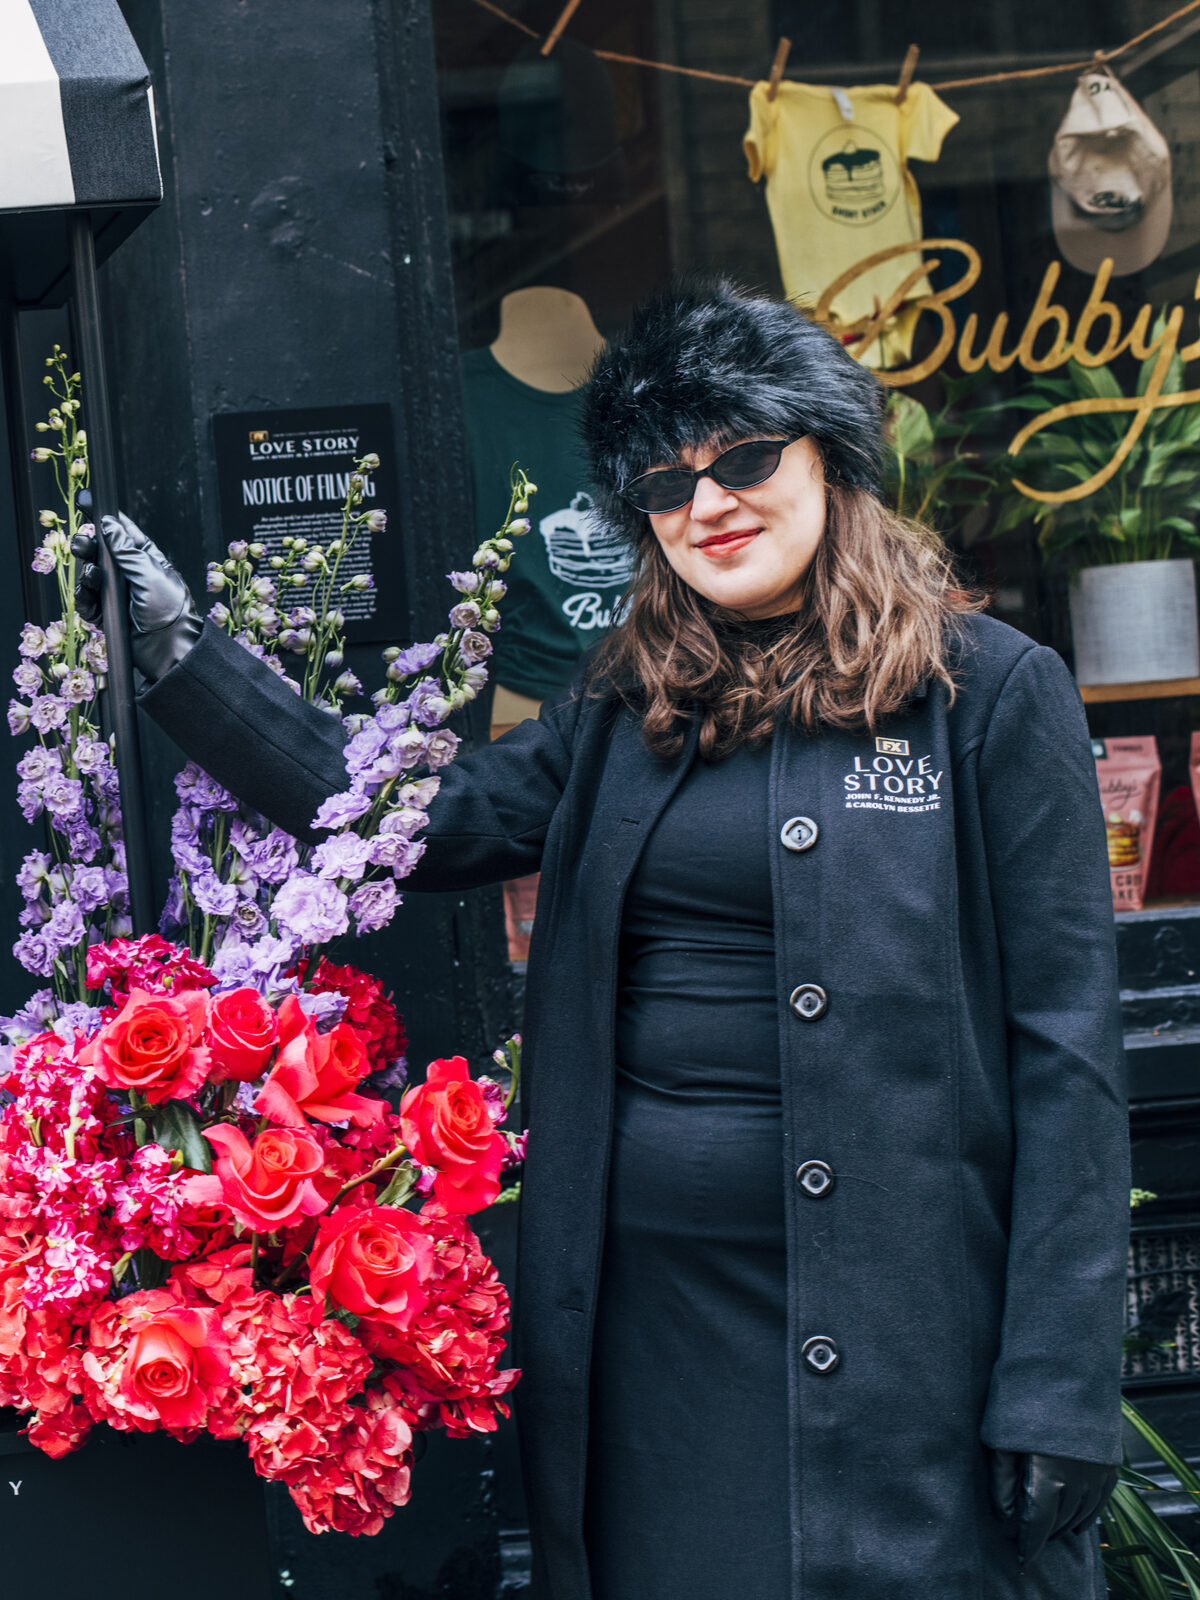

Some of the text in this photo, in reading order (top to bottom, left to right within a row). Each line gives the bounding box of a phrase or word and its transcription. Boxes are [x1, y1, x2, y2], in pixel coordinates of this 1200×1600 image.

[249, 440, 296, 456] LOVE
[302, 436, 360, 451] STORY
[242, 472, 376, 506] NOTICE OF FILMG
[882, 741, 902, 752] FX
[854, 754, 933, 776] LOVE
[843, 771, 943, 795] STORY
[853, 802, 896, 812] CAROLYN
[897, 802, 941, 813] BESSETTE
[884, 795, 925, 804] KENNEDY
